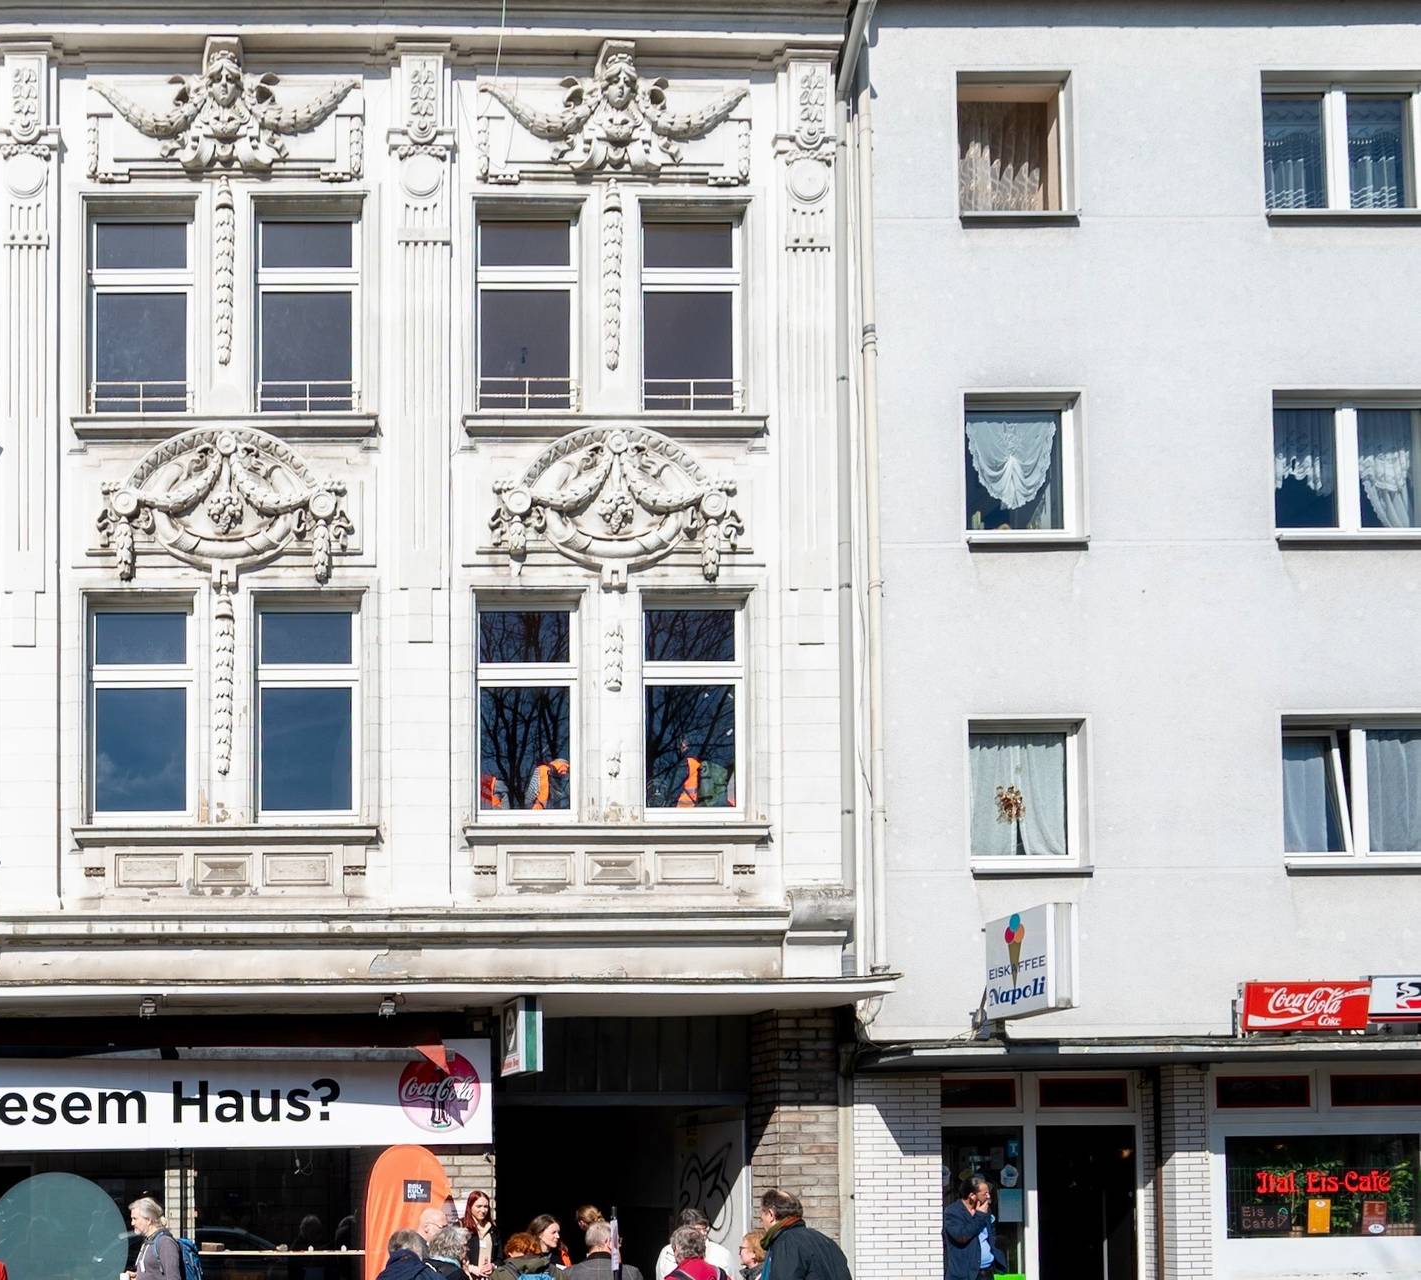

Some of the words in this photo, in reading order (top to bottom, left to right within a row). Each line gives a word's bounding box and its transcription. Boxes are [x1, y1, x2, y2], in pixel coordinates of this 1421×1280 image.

[988, 955, 1046, 980] EISKAFFEE
[989, 976, 1046, 1006] Napoli
[1268, 987, 1345, 1014] Coca-Cola
[1318, 1015, 1342, 1026] Coke
[172, 1078, 341, 1122] Haus?
[401, 1075, 477, 1102] Coca-Cola
[1305, 1169, 1392, 1193] Eis-Café
[1241, 1206, 1265, 1217] Eis
[1241, 1217, 1275, 1230] Café
